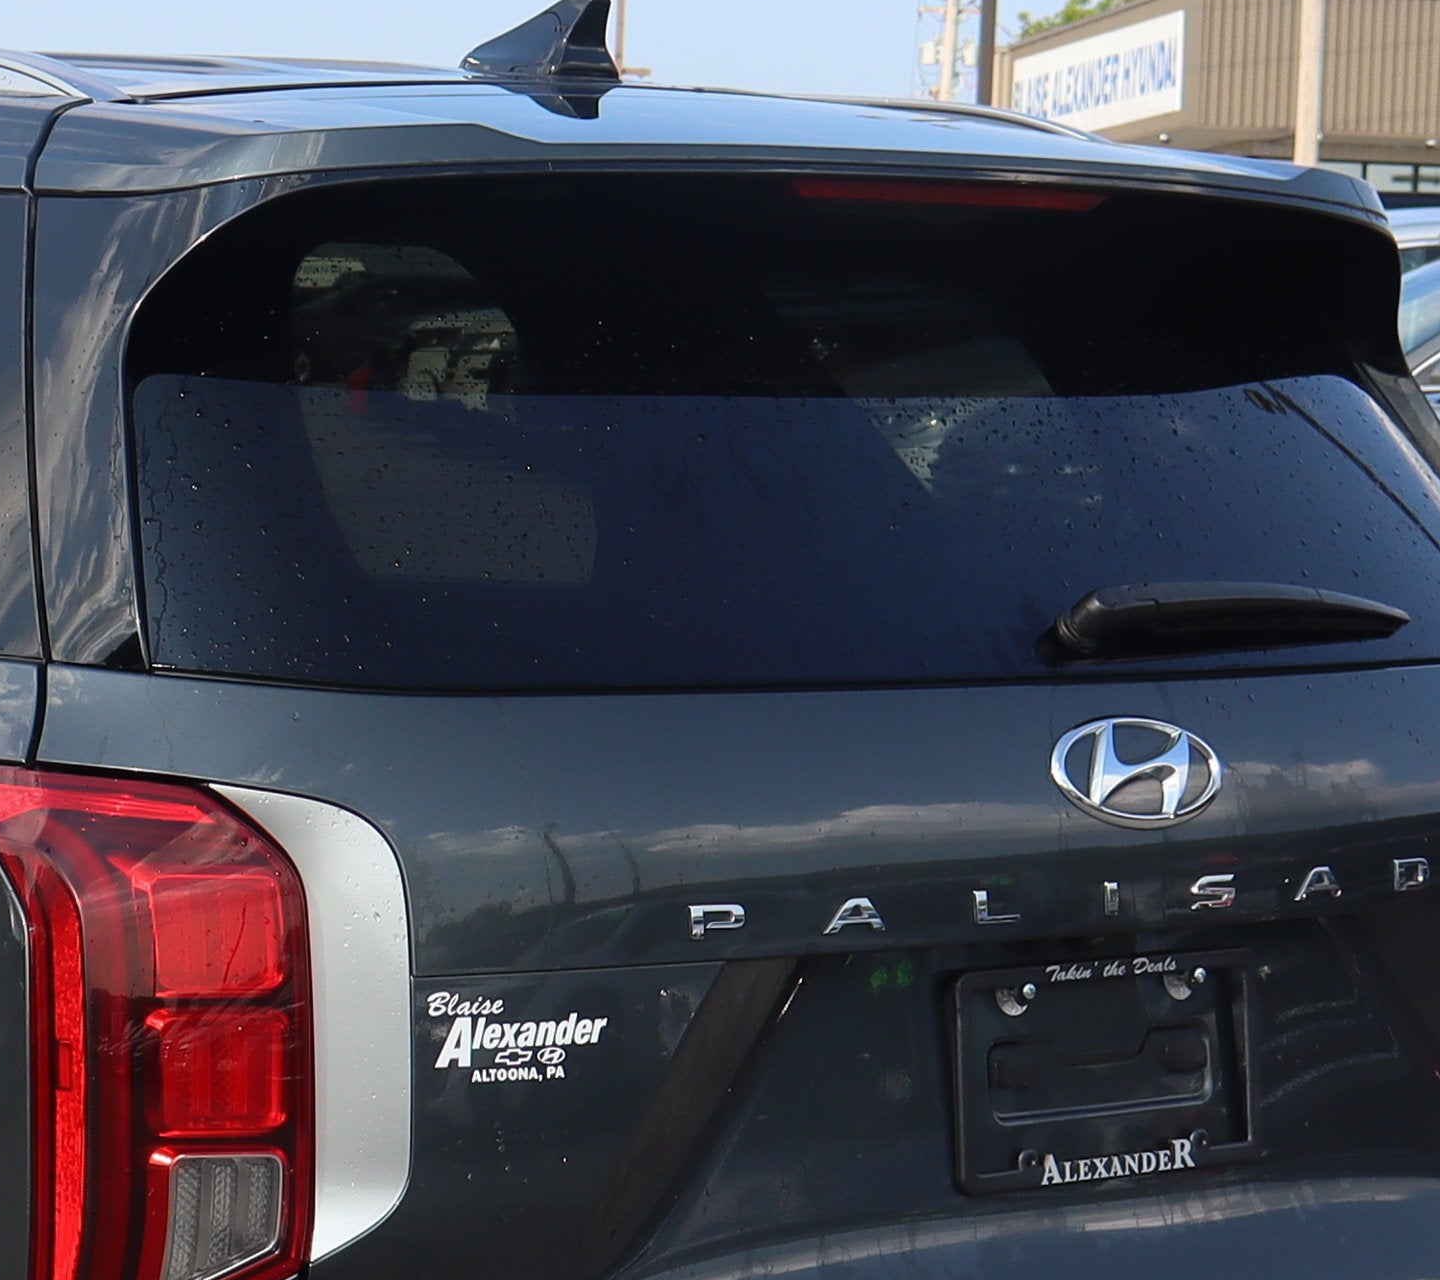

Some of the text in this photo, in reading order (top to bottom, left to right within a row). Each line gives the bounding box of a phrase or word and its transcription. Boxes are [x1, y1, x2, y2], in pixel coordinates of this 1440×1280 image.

[1051, 54, 1119, 117] ALEXANDER
[1122, 36, 1177, 100] HYUNDAI
[1045, 956, 1177, 982] Takin' the Deals
[426, 991, 505, 1017] Blaise
[434, 1012, 609, 1069] Alexander
[471, 1066, 566, 1083] ALTOONA, PA
